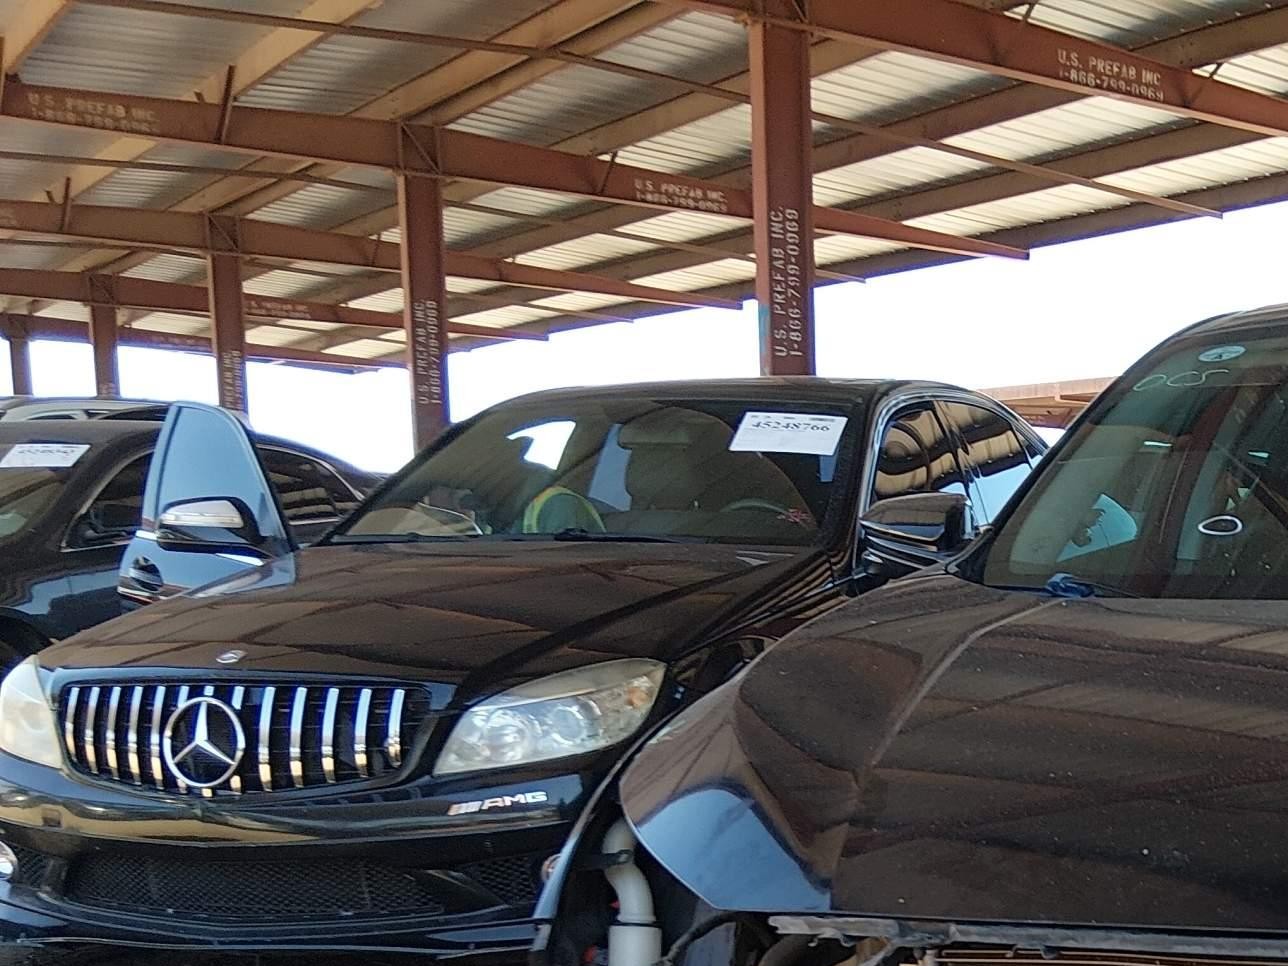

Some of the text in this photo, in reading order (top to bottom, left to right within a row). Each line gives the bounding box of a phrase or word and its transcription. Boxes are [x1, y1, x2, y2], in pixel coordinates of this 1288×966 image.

[1057, 49, 1083, 68] U.S.
[1088, 56, 1137, 80] PREFAB
[769, 205, 788, 356] U.S. PREFAB INC.
[784, 208, 803, 356] 1-866-799-0969
[751, 421, 831, 432] 45248766
[481, 791, 548, 810] AMG
